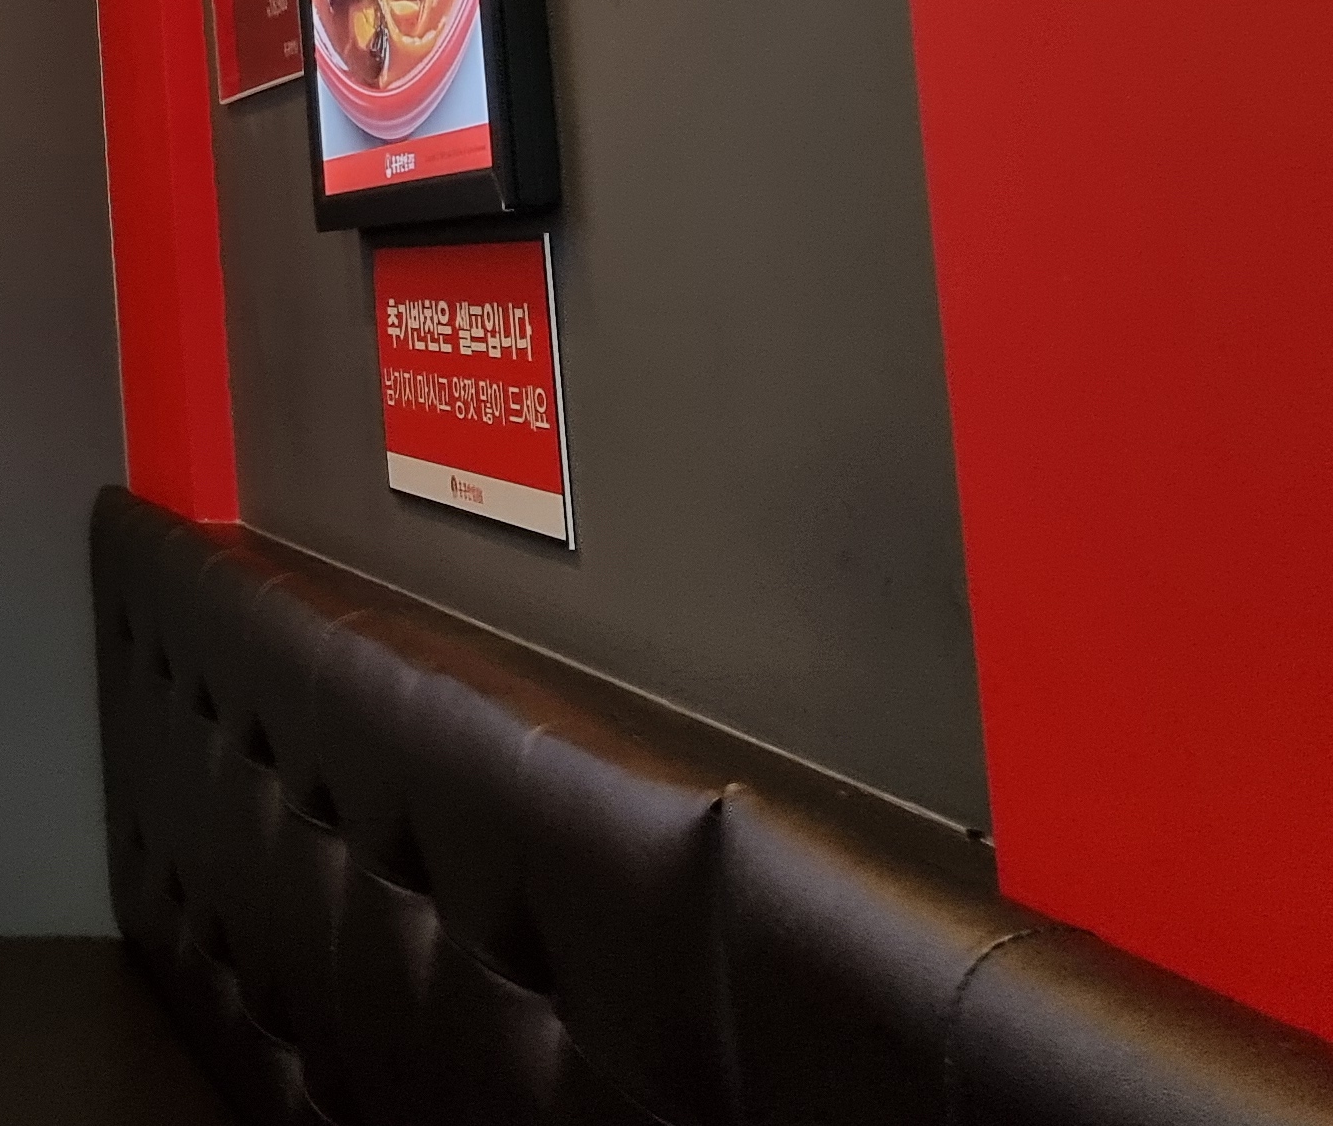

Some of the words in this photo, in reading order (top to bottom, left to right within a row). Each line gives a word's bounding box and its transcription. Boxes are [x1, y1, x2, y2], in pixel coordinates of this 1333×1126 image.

[387, 298, 452, 353] 추가반찬은
[455, 301, 532, 362] 셀프입니다
[384, 367, 415, 410] 남기지
[416, 371, 451, 414] 마시고
[452, 376, 478, 421] 양껏
[478, 379, 506, 426] 많이
[508, 385, 550, 432] 드세요
